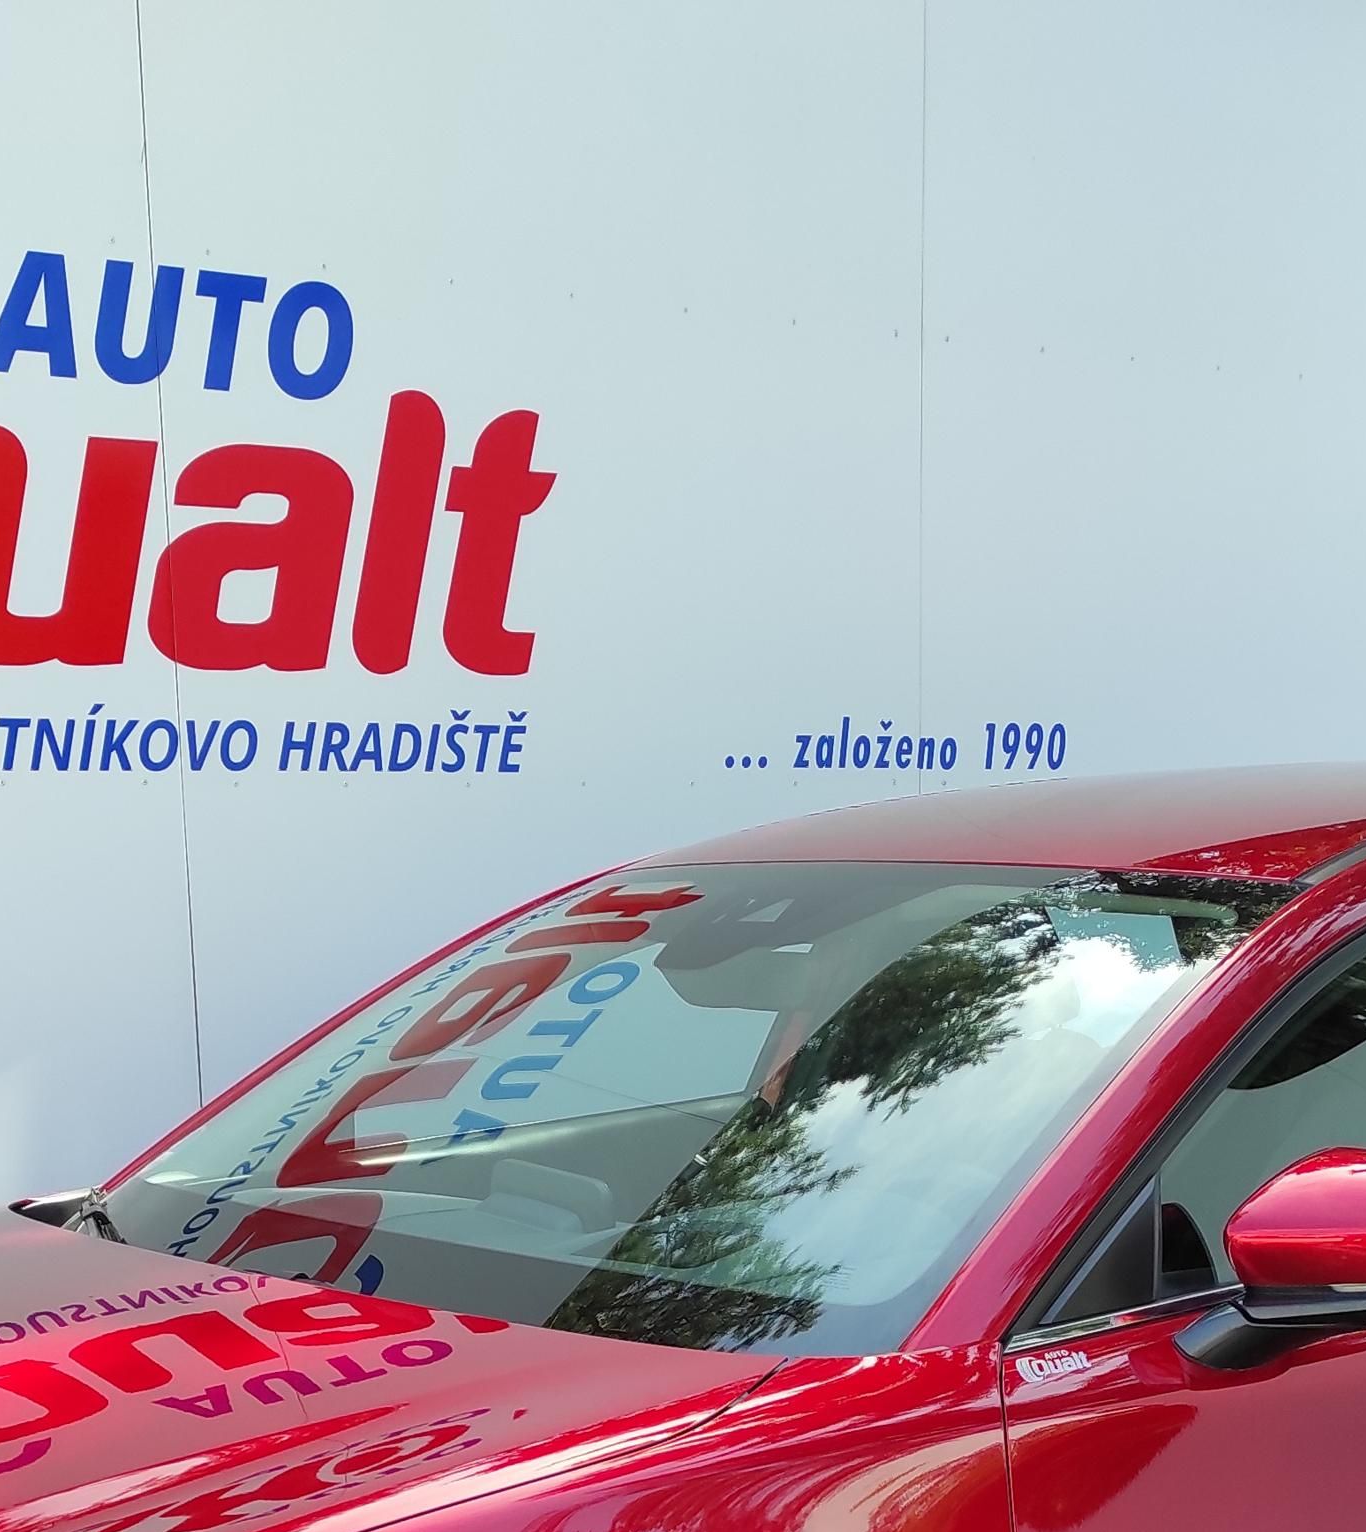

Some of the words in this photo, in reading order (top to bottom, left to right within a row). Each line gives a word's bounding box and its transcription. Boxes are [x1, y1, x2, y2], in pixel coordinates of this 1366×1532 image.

[278, 709, 528, 774] HRADIŠTĚ
[793, 716, 958, 771] založeno
[984, 722, 1067, 771] 1990
[1031, 1350, 1093, 1378] Qualt
[1044, 1349, 1069, 1361] AUTO
